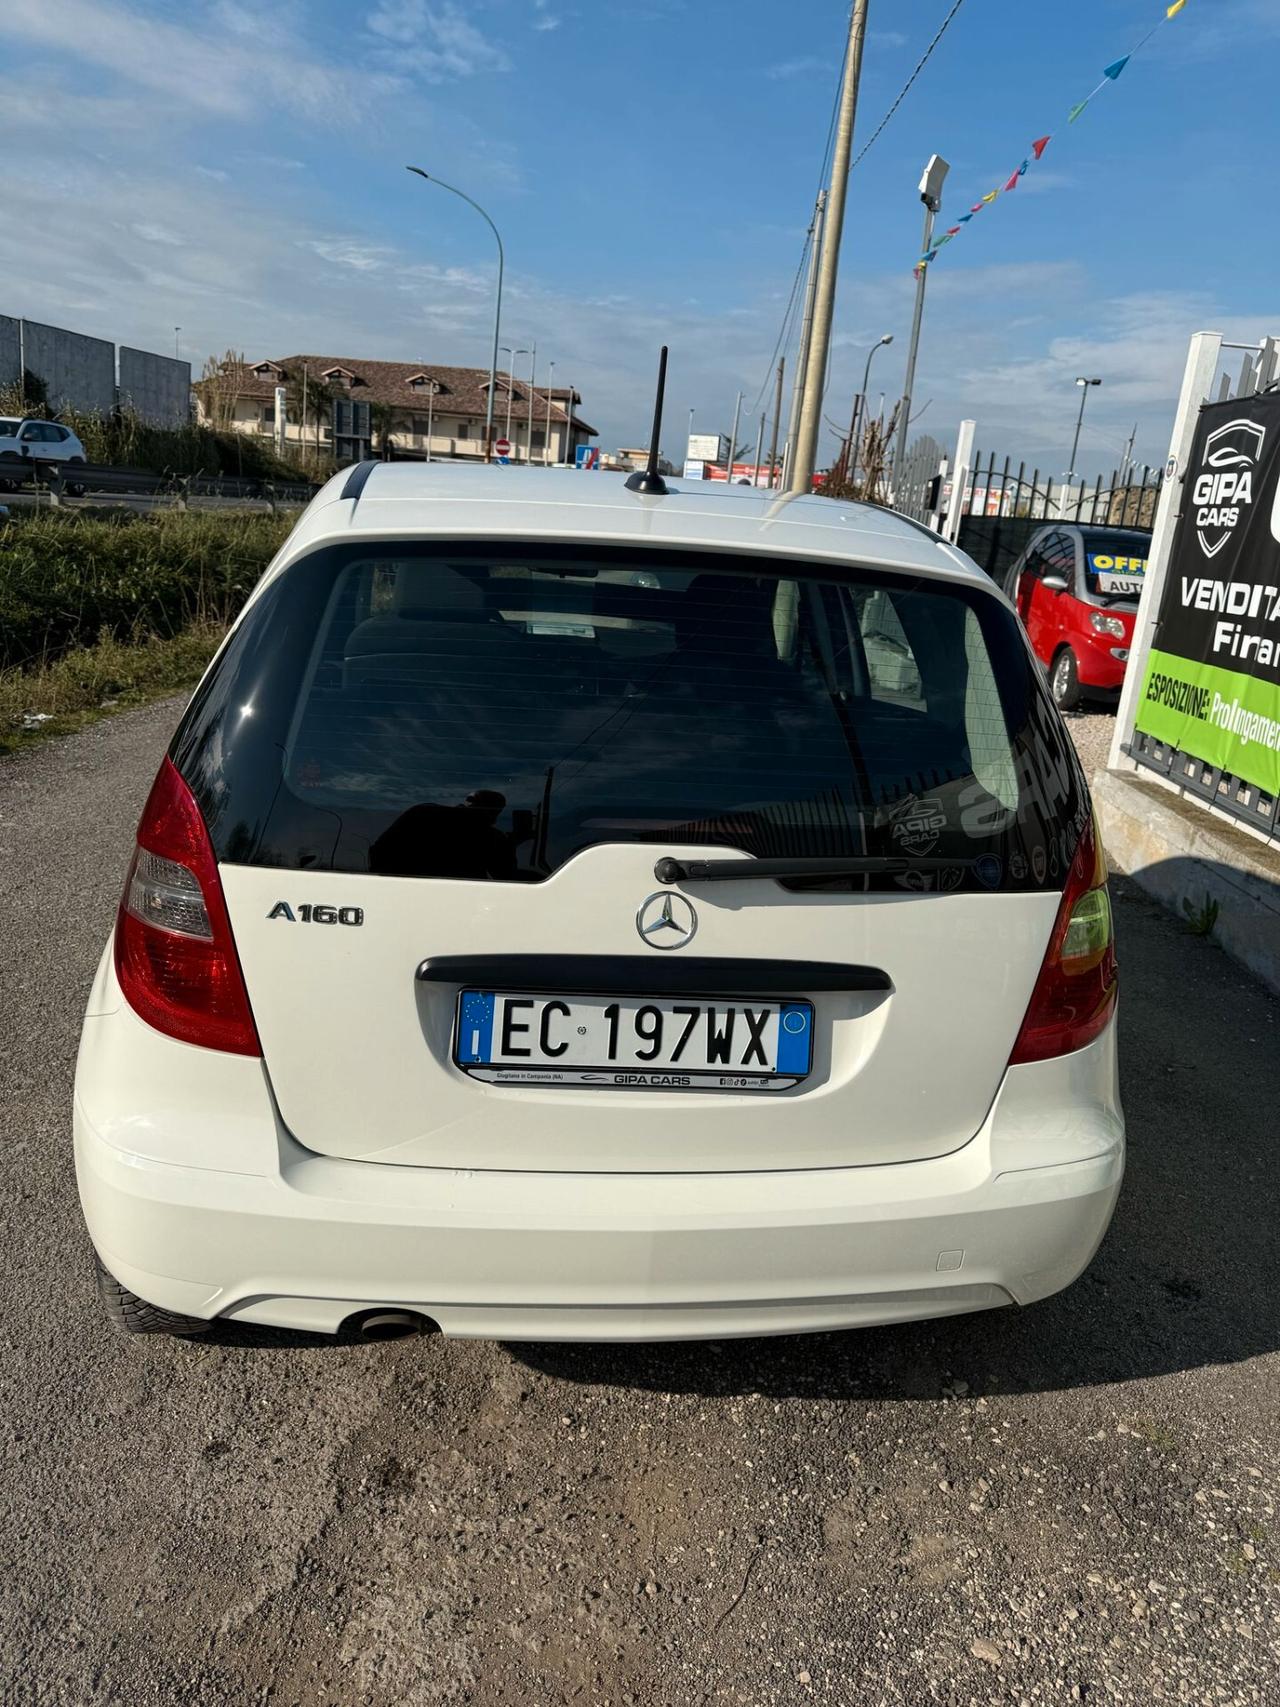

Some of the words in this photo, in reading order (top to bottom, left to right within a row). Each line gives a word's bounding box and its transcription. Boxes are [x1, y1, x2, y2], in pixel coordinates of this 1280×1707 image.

[1192, 471, 1252, 505] GIPA
[1196, 507, 1240, 527] CARS
[1146, 672, 1210, 721] ESPOSIZIONE:
[265, 901, 364, 927] A160
[501, 998, 571, 1058] EC
[603, 1003, 772, 1066] 197WX
[614, 1075, 649, 1085] GIPA
[650, 1077, 691, 1086] CARS
